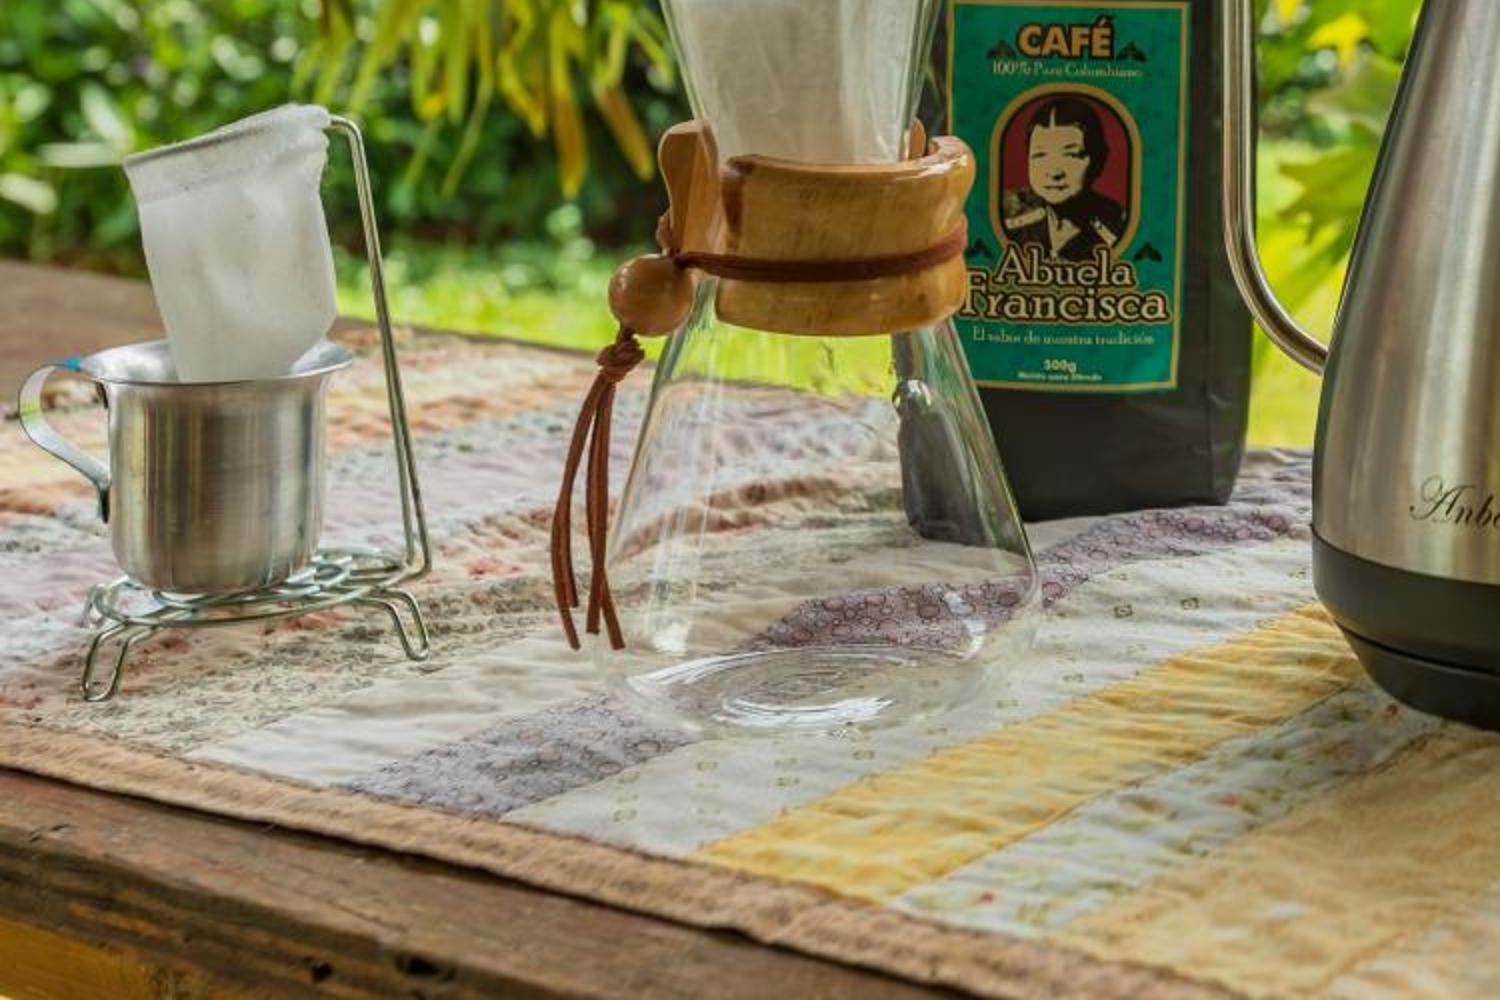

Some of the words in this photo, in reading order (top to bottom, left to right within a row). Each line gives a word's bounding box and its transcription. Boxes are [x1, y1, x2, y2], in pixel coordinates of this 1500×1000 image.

[1017, 16, 1113, 58] CAFÉ
[994, 246, 1134, 286] Abuela
[961, 269, 1168, 320] Francisca
